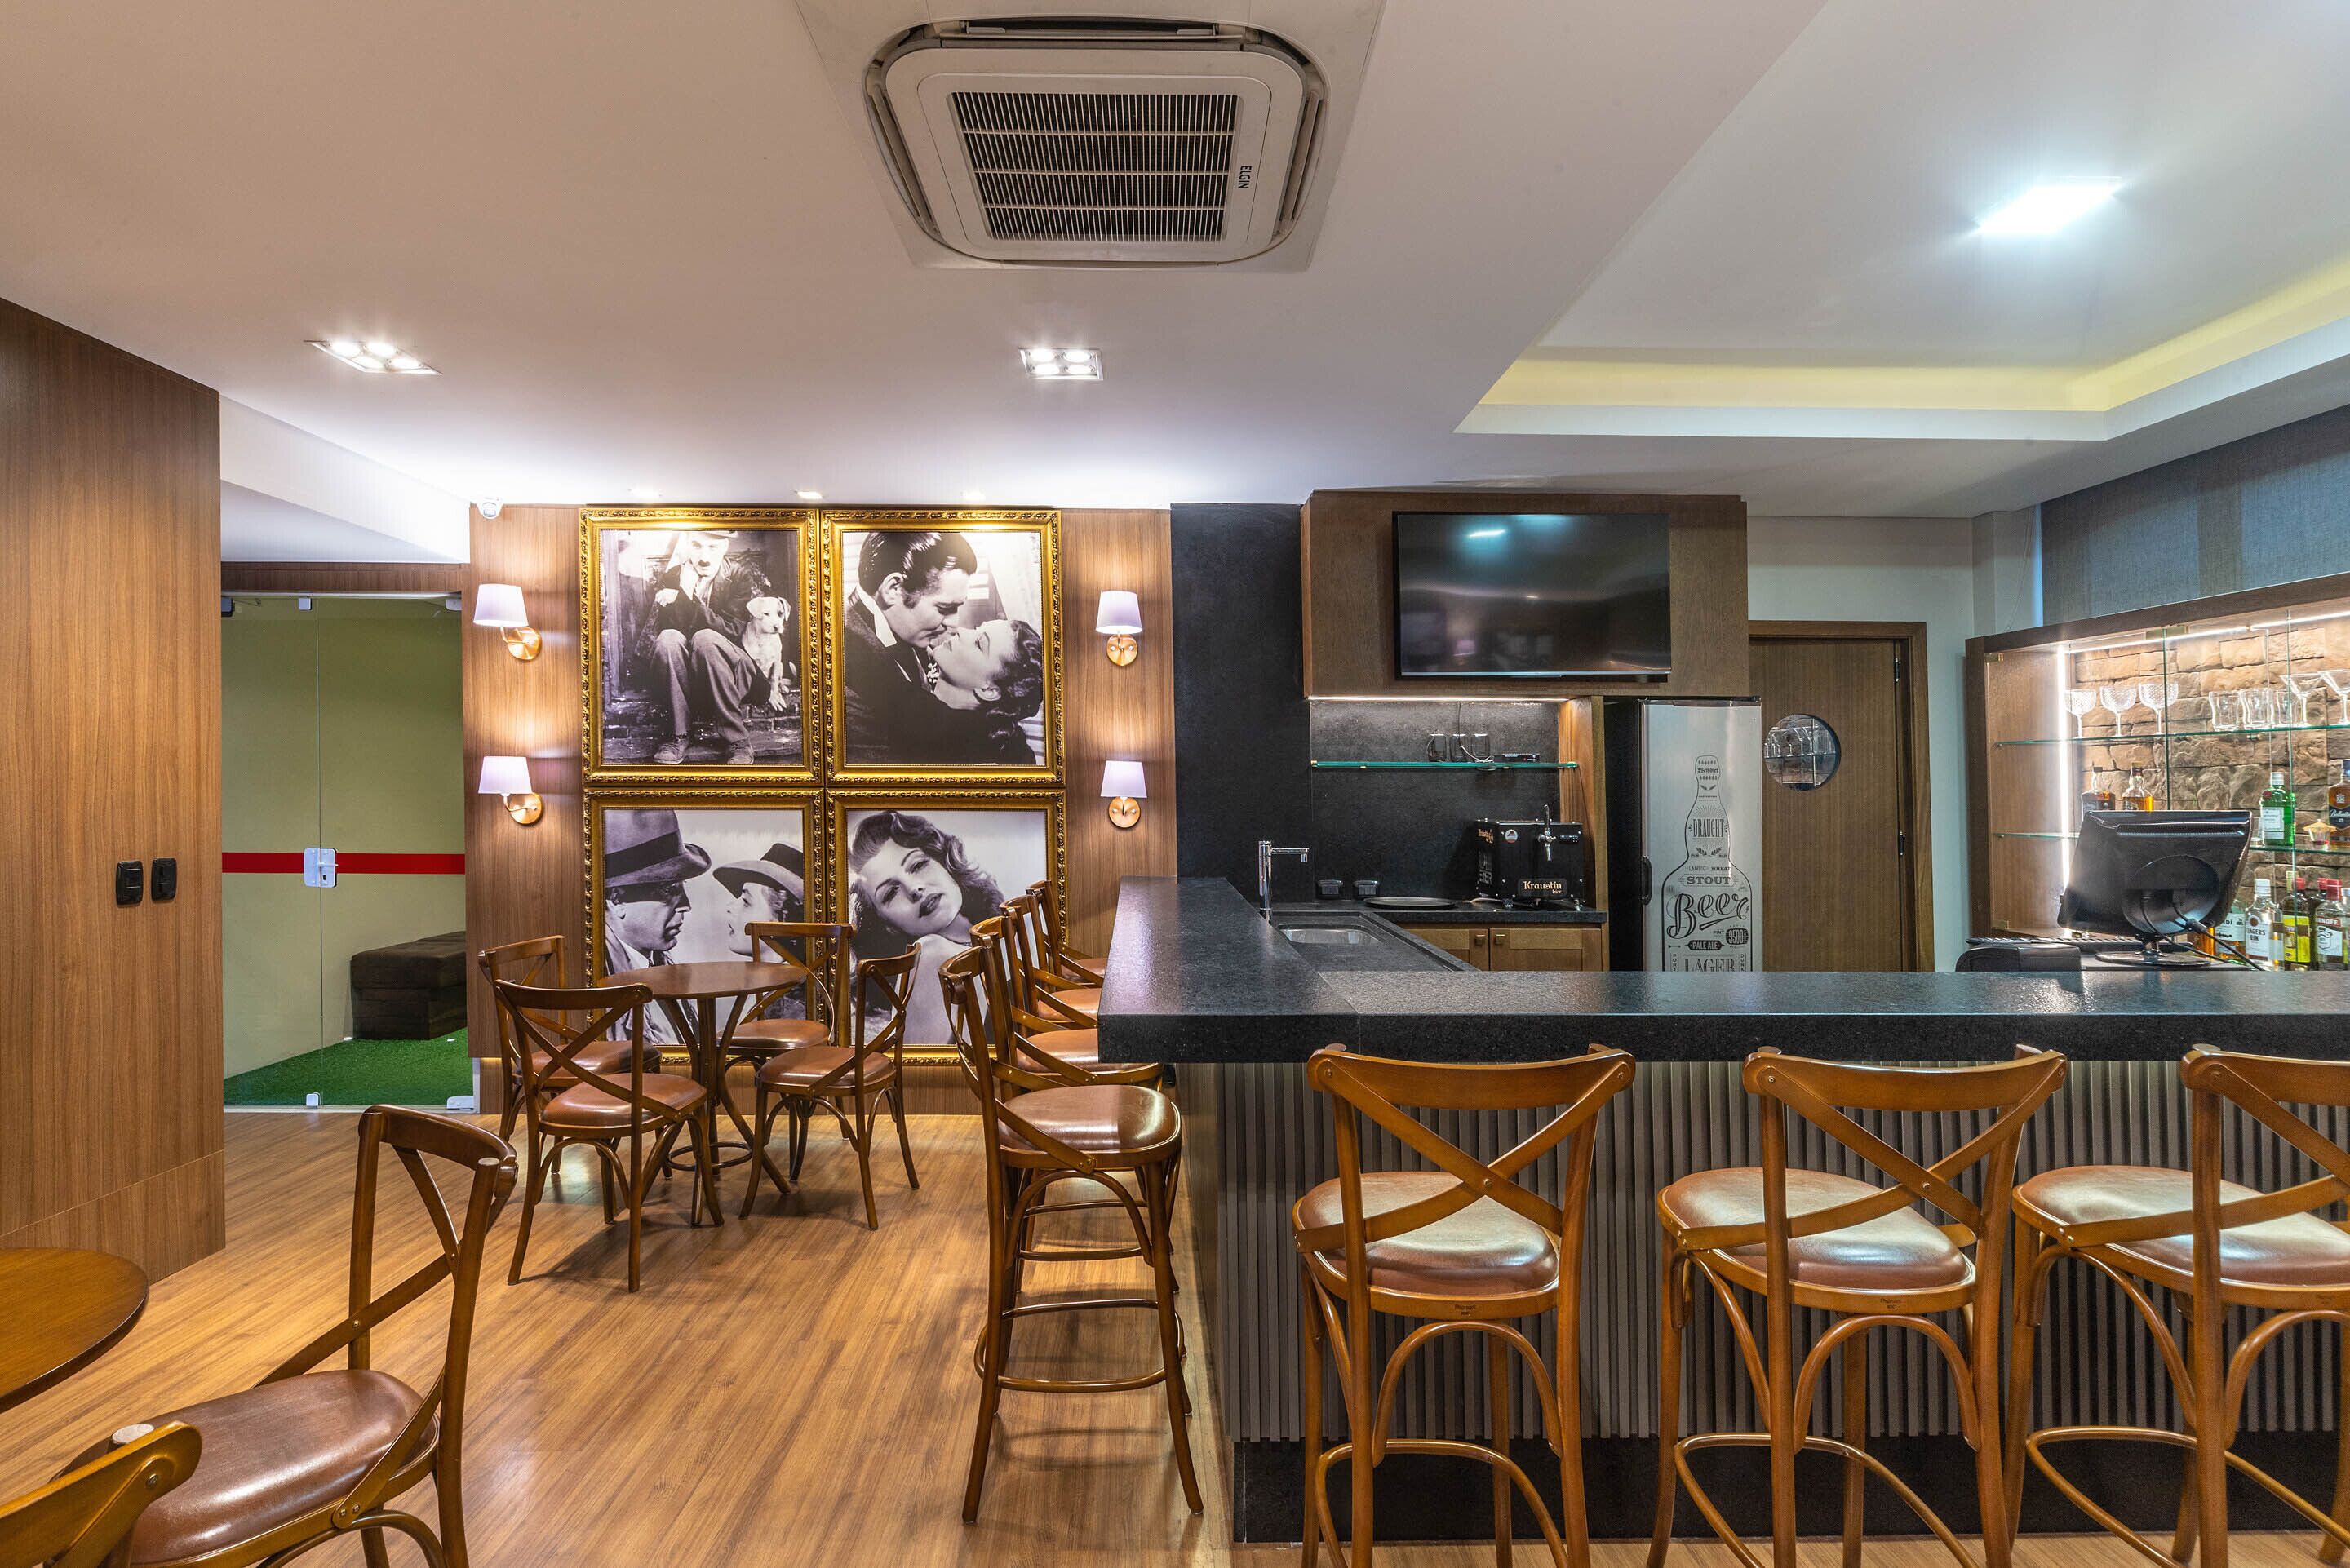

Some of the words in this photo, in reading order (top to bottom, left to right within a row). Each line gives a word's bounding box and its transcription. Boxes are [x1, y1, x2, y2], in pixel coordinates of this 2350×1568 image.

[1237, 165, 1253, 189] ELGIN
[1693, 818, 1724, 838] DRAUGHT
[1523, 880, 1563, 890] Kraustin
[1687, 876, 1731, 885] STOUT
[1666, 893, 1749, 939] Beer
[1692, 941, 1707, 950] PALE
[1707, 941, 1718, 950] ALE
